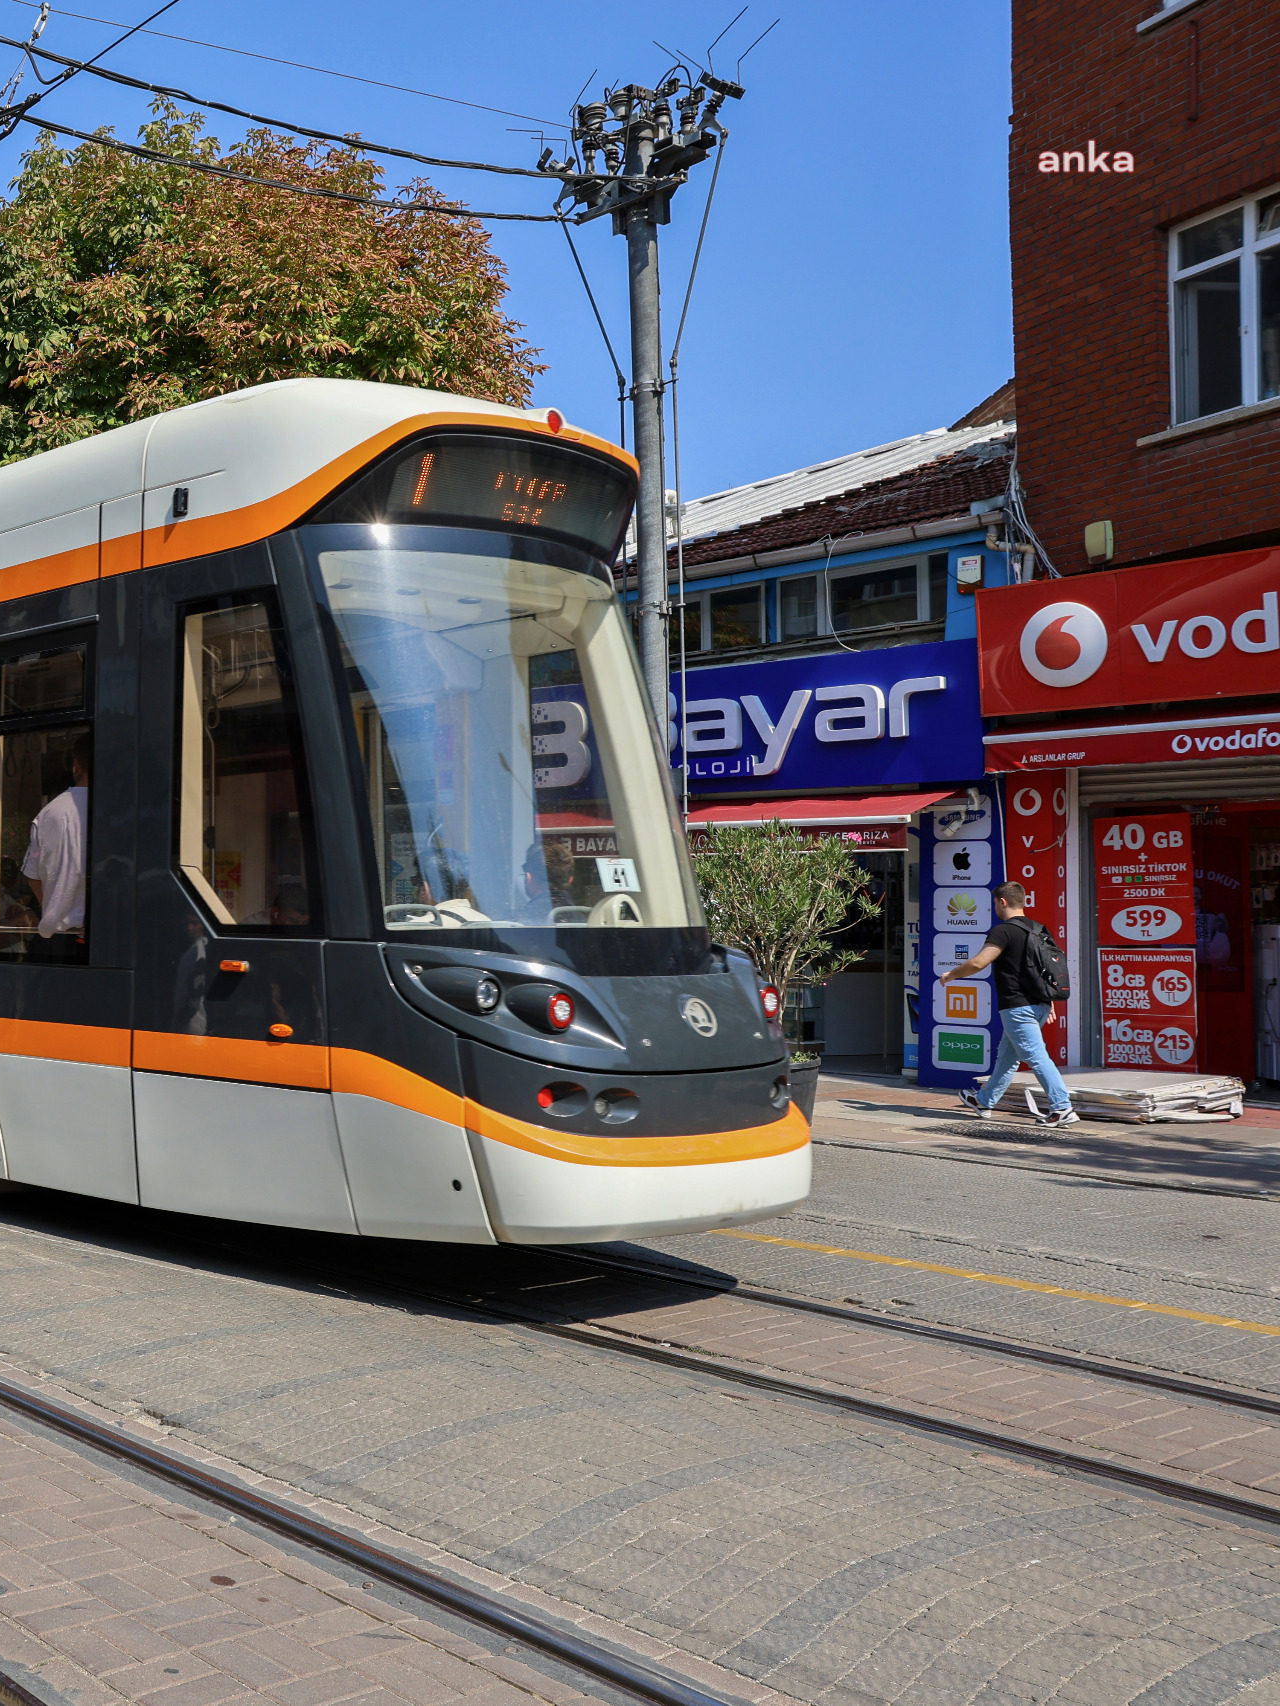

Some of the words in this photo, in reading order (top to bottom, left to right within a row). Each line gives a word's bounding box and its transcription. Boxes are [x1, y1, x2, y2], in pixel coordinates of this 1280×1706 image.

[1029, 753, 1066, 763] ARSLANLAR
[1067, 751, 1086, 761] GRUP
[1102, 823, 1145, 851] 40
[1152, 830, 1184, 848] GB
[1101, 864, 1147, 875] SINIRSIZ
[1147, 862, 1187, 873] TİKTOK
[1144, 874, 1177, 882] SINIRSIZ
[1123, 888, 1148, 898] 2500
[1150, 887, 1166, 896] DK
[1125, 909, 1167, 927] 599
[1140, 929, 1152, 937] TL
[1102, 953, 1116, 961] İLK
[1116, 954, 1142, 962] HATTIM
[1143, 955, 1192, 963] KAMPANYASI
[1156, 976, 1188, 992] 165
[1105, 989, 1132, 999] 1000
[1133, 989, 1149, 1000] DK
[1165, 992, 1180, 1002] TL
[1106, 999, 1126, 1008] 250
[1127, 1000, 1151, 1009] SMS
[1157, 1033, 1190, 1050] 215
[1107, 1044, 1134, 1054] 1000
[1135, 1044, 1151, 1055] DK
[1167, 1049, 1182, 1060] TL
[1107, 1053, 1128, 1063] 250
[1129, 1054, 1153, 1065] SMS
